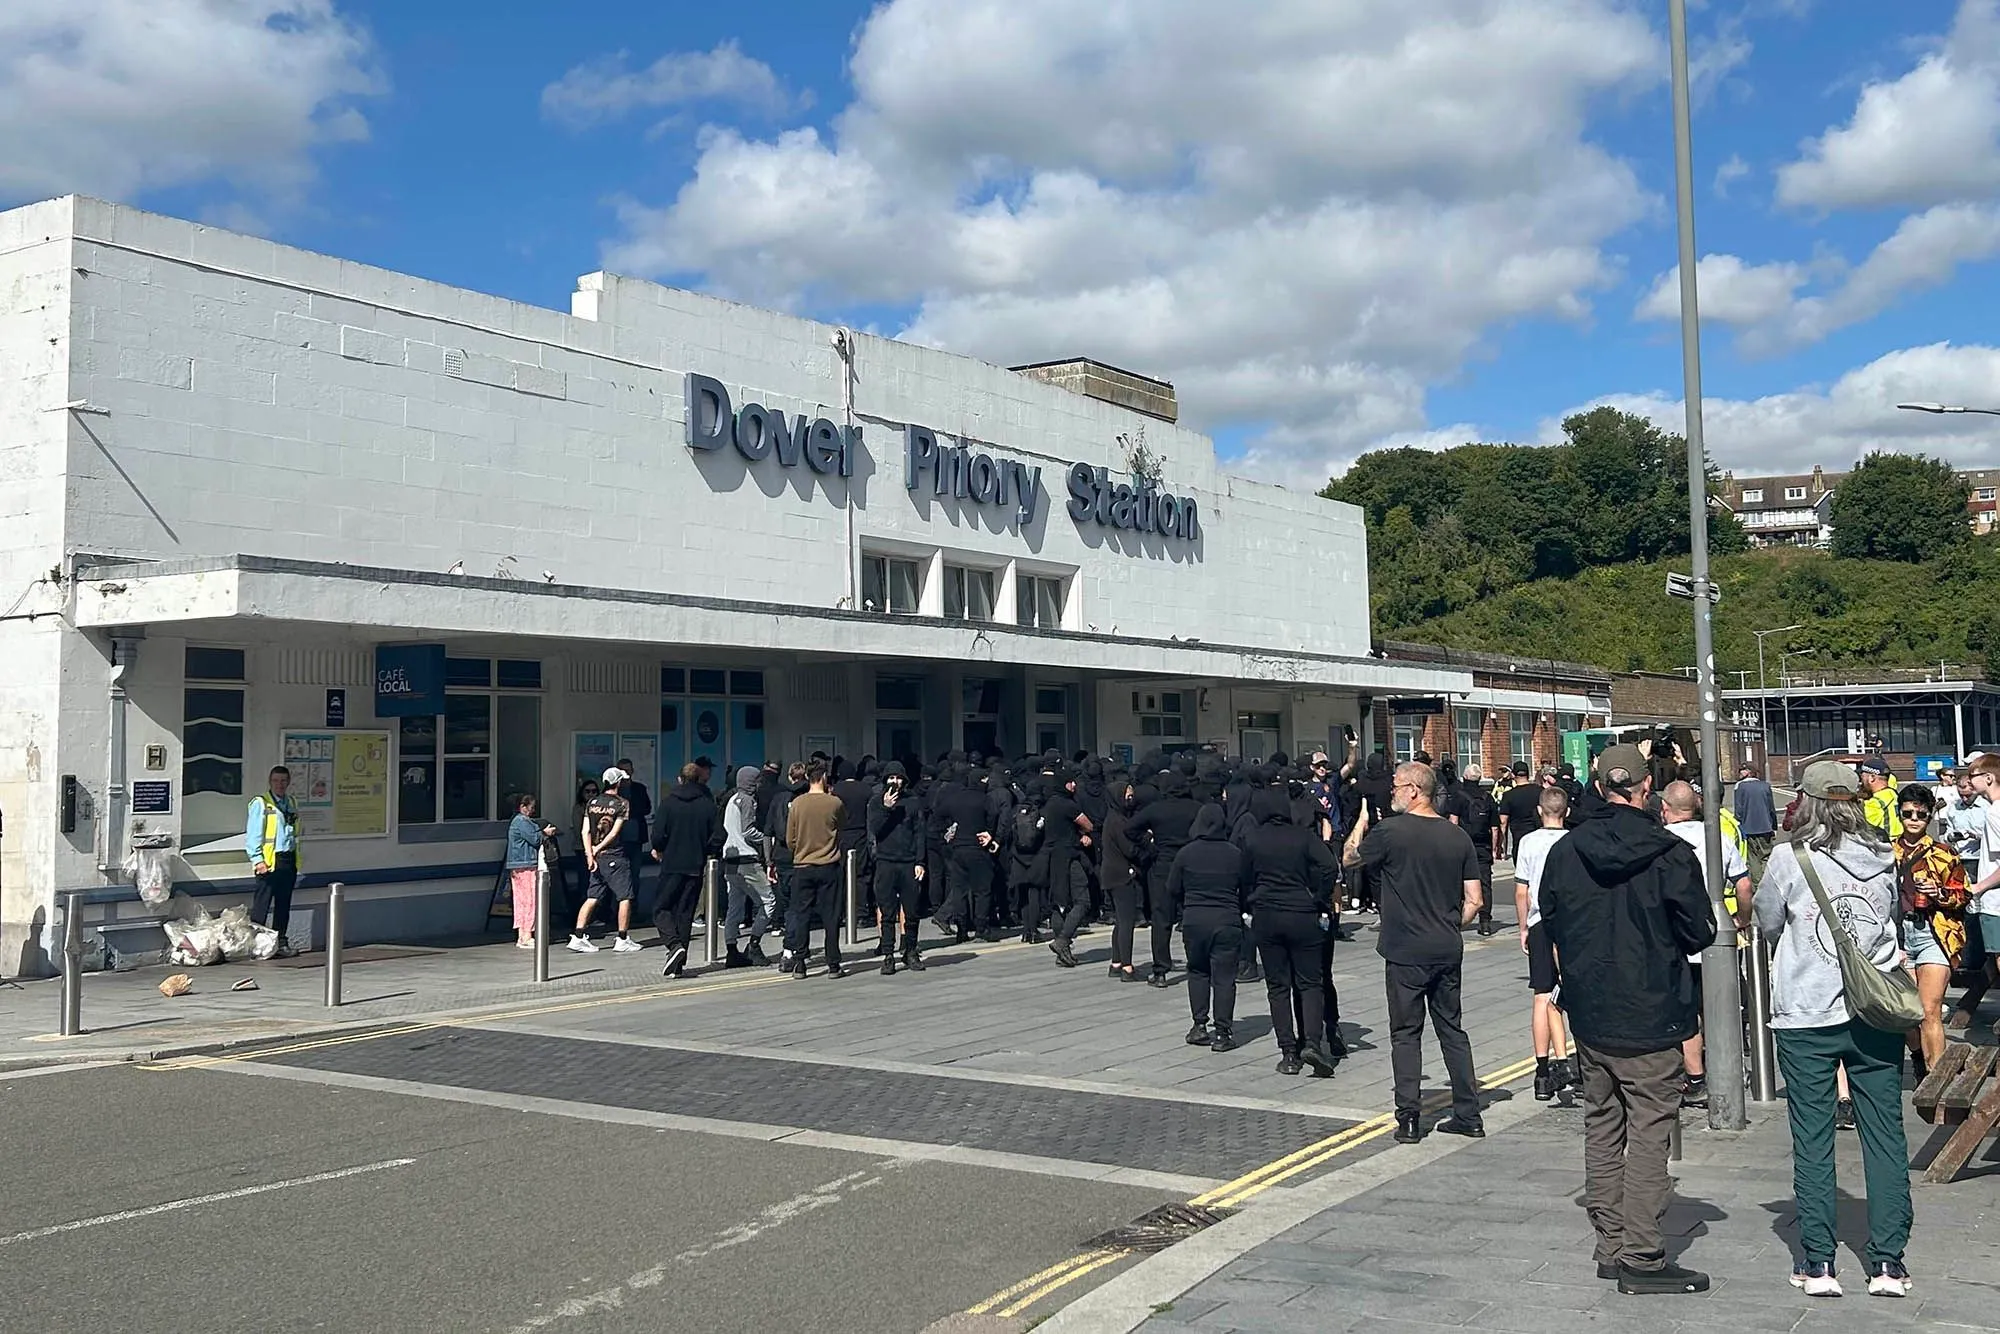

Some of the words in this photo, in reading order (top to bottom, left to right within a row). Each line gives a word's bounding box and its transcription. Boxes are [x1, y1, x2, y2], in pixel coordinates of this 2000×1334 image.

[687, 372, 862, 477] Dover
[905, 424, 1042, 524] Priory
[1066, 462, 1199, 540] Station
[378, 666, 405, 682] CAFÉ
[378, 680, 411, 693] LOCAL
[149, 748, 162, 766] H
[1843, 884, 1886, 921] PROJECT
[1808, 935, 1832, 965] BELGIAN
